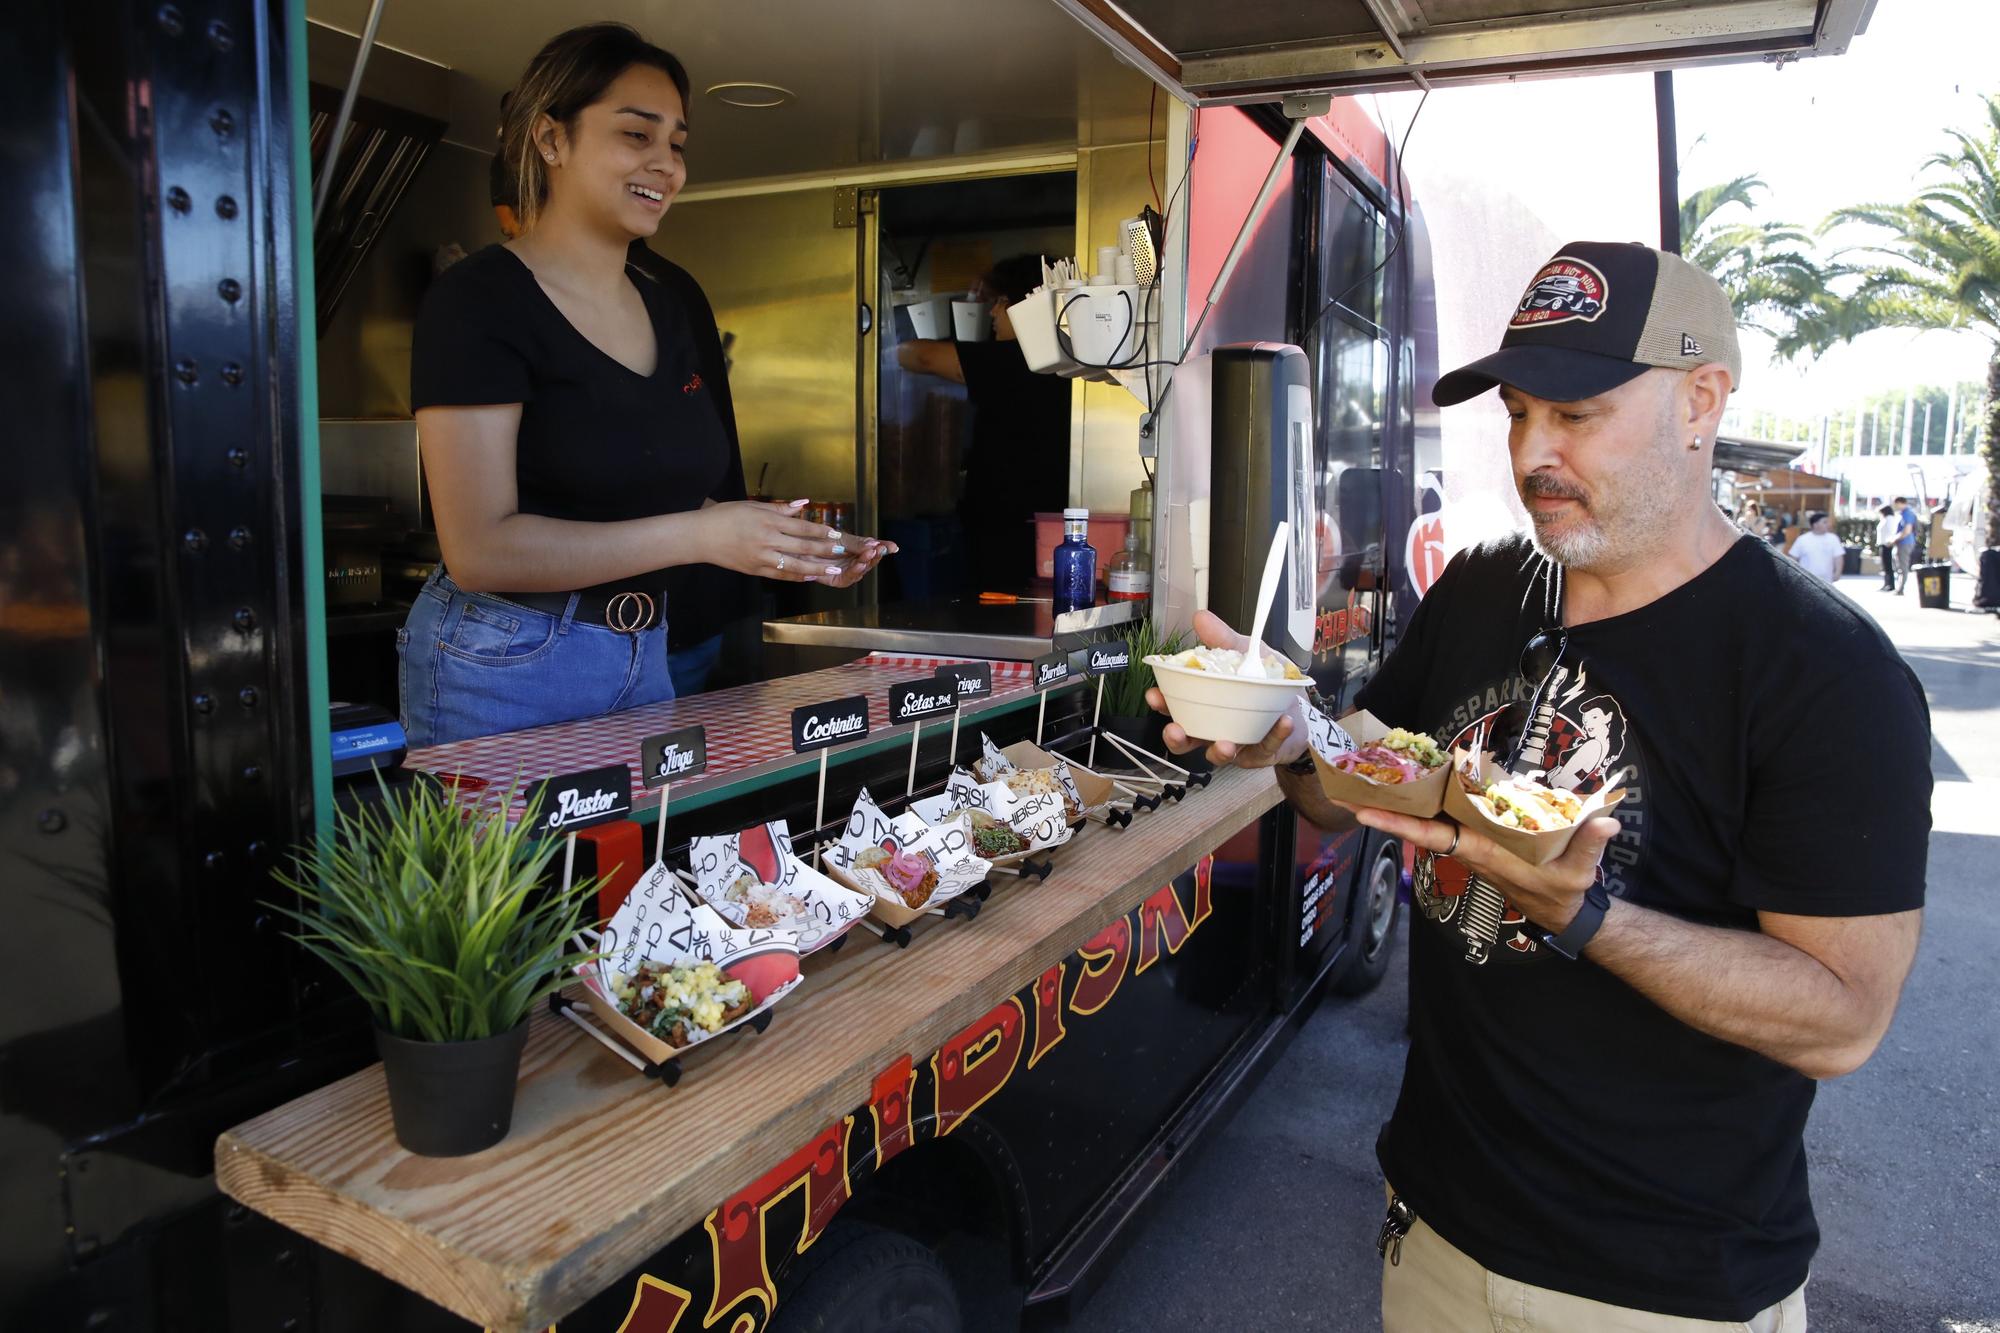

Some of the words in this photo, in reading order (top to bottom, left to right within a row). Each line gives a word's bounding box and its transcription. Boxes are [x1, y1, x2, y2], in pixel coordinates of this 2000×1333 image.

[1563, 265, 1582, 278] HOT
[1579, 273, 1598, 295] RODS
[955, 674, 982, 694] ringa
[900, 692, 934, 717] Setas
[1453, 676, 1529, 729] SPARK
[802, 712, 864, 741] Cochinita
[660, 743, 695, 777] Tinga
[550, 787, 619, 828] Pastor
[1608, 763, 1644, 867] SPEED
